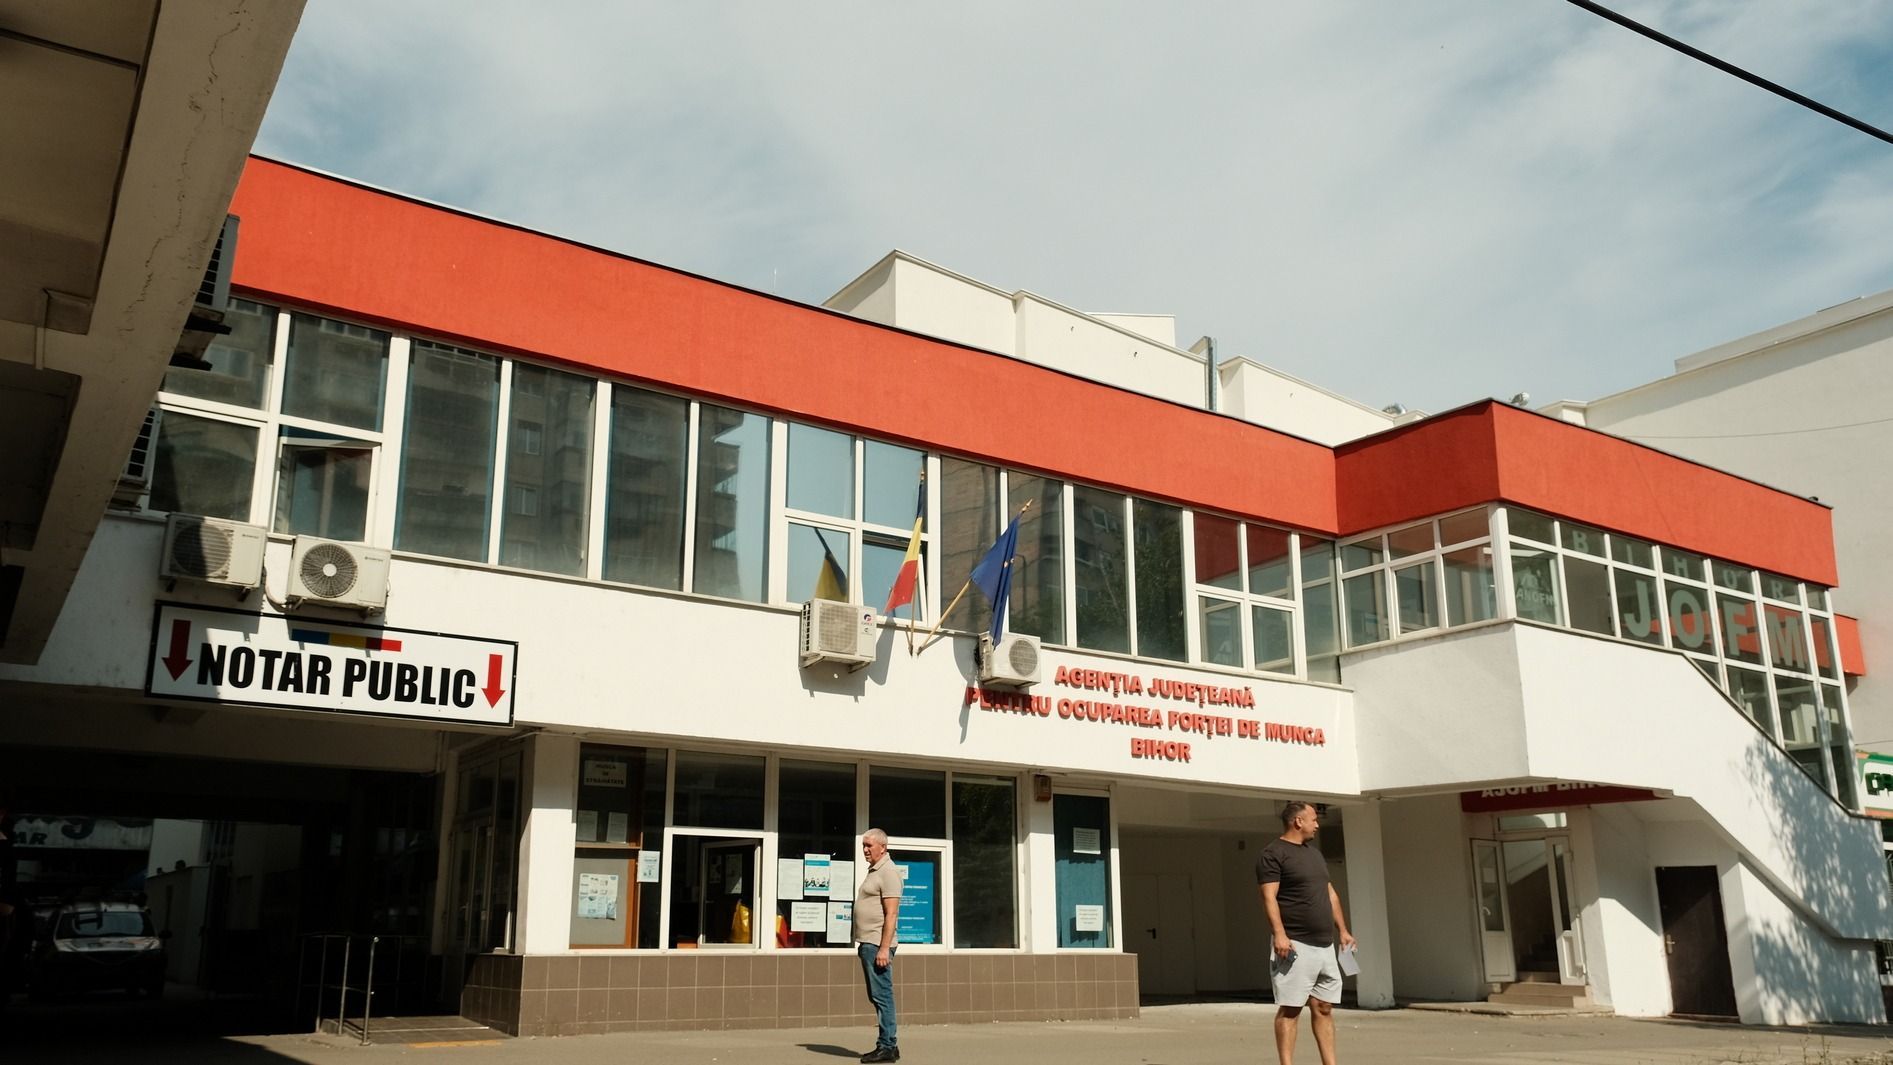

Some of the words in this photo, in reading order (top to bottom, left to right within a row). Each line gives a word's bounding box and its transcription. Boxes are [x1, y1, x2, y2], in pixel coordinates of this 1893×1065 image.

[1623, 580, 1808, 670] JOFM
[197, 643, 332, 696] NOTAR
[342, 657, 476, 709] PUBLIC
[1055, 665, 1142, 698] AGENȚIA
[1147, 677, 1256, 709] JUDEȚEANĂ
[965, 687, 1053, 716] PENTRU
[1057, 697, 1164, 727] OCUPAREA
[1167, 711, 1233, 738] FORȚEI
[1238, 720, 1261, 738] DE
[1131, 737, 1192, 762] BIHOR
